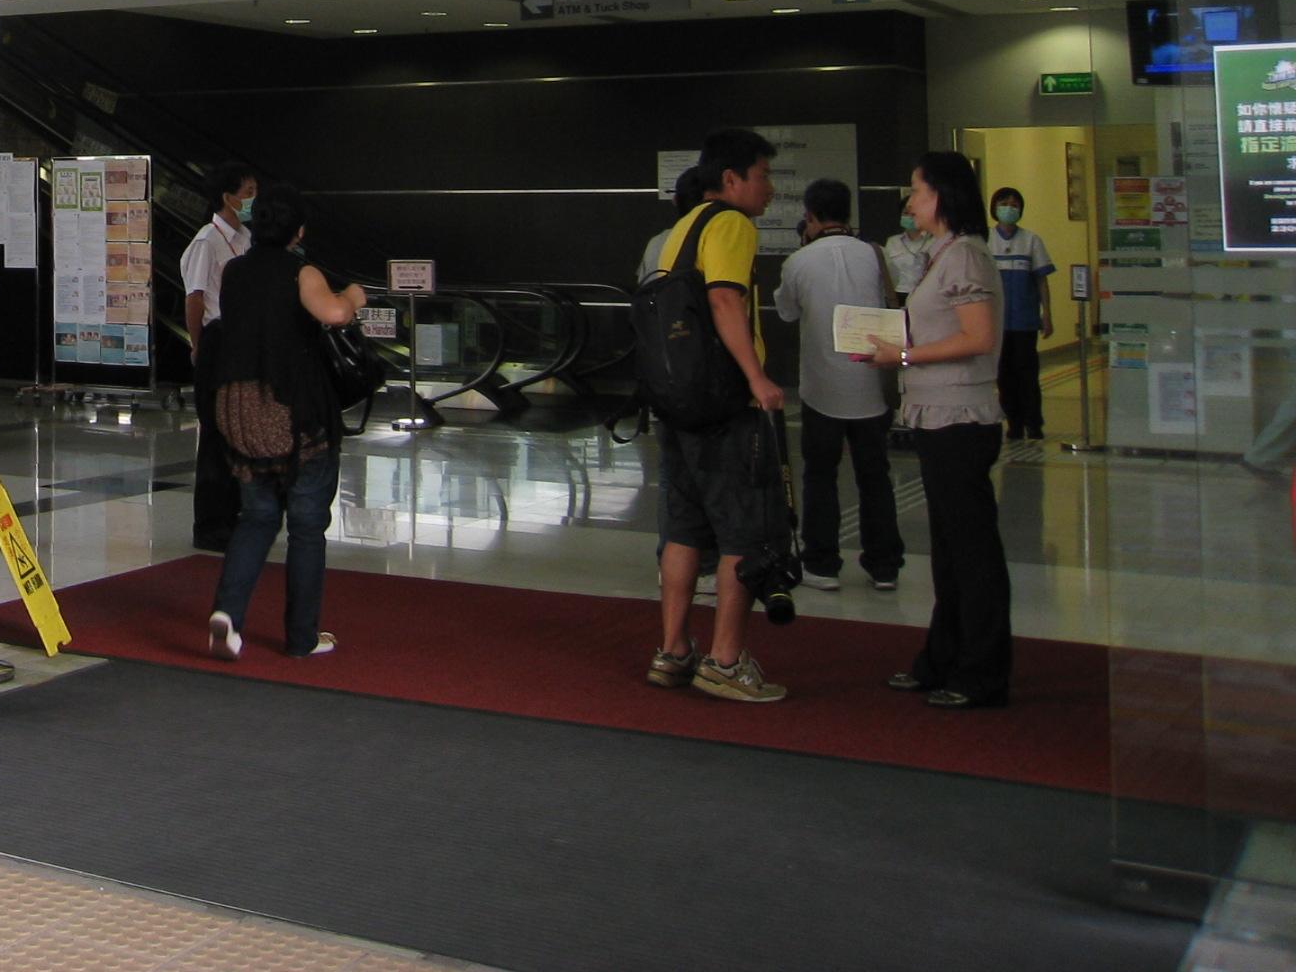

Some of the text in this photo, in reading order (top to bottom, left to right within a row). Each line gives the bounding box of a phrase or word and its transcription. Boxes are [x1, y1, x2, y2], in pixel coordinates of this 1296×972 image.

[558, 5, 582, 16] ATM
[595, 3, 619, 13] Tuck
[622, 0, 650, 12] Shop
